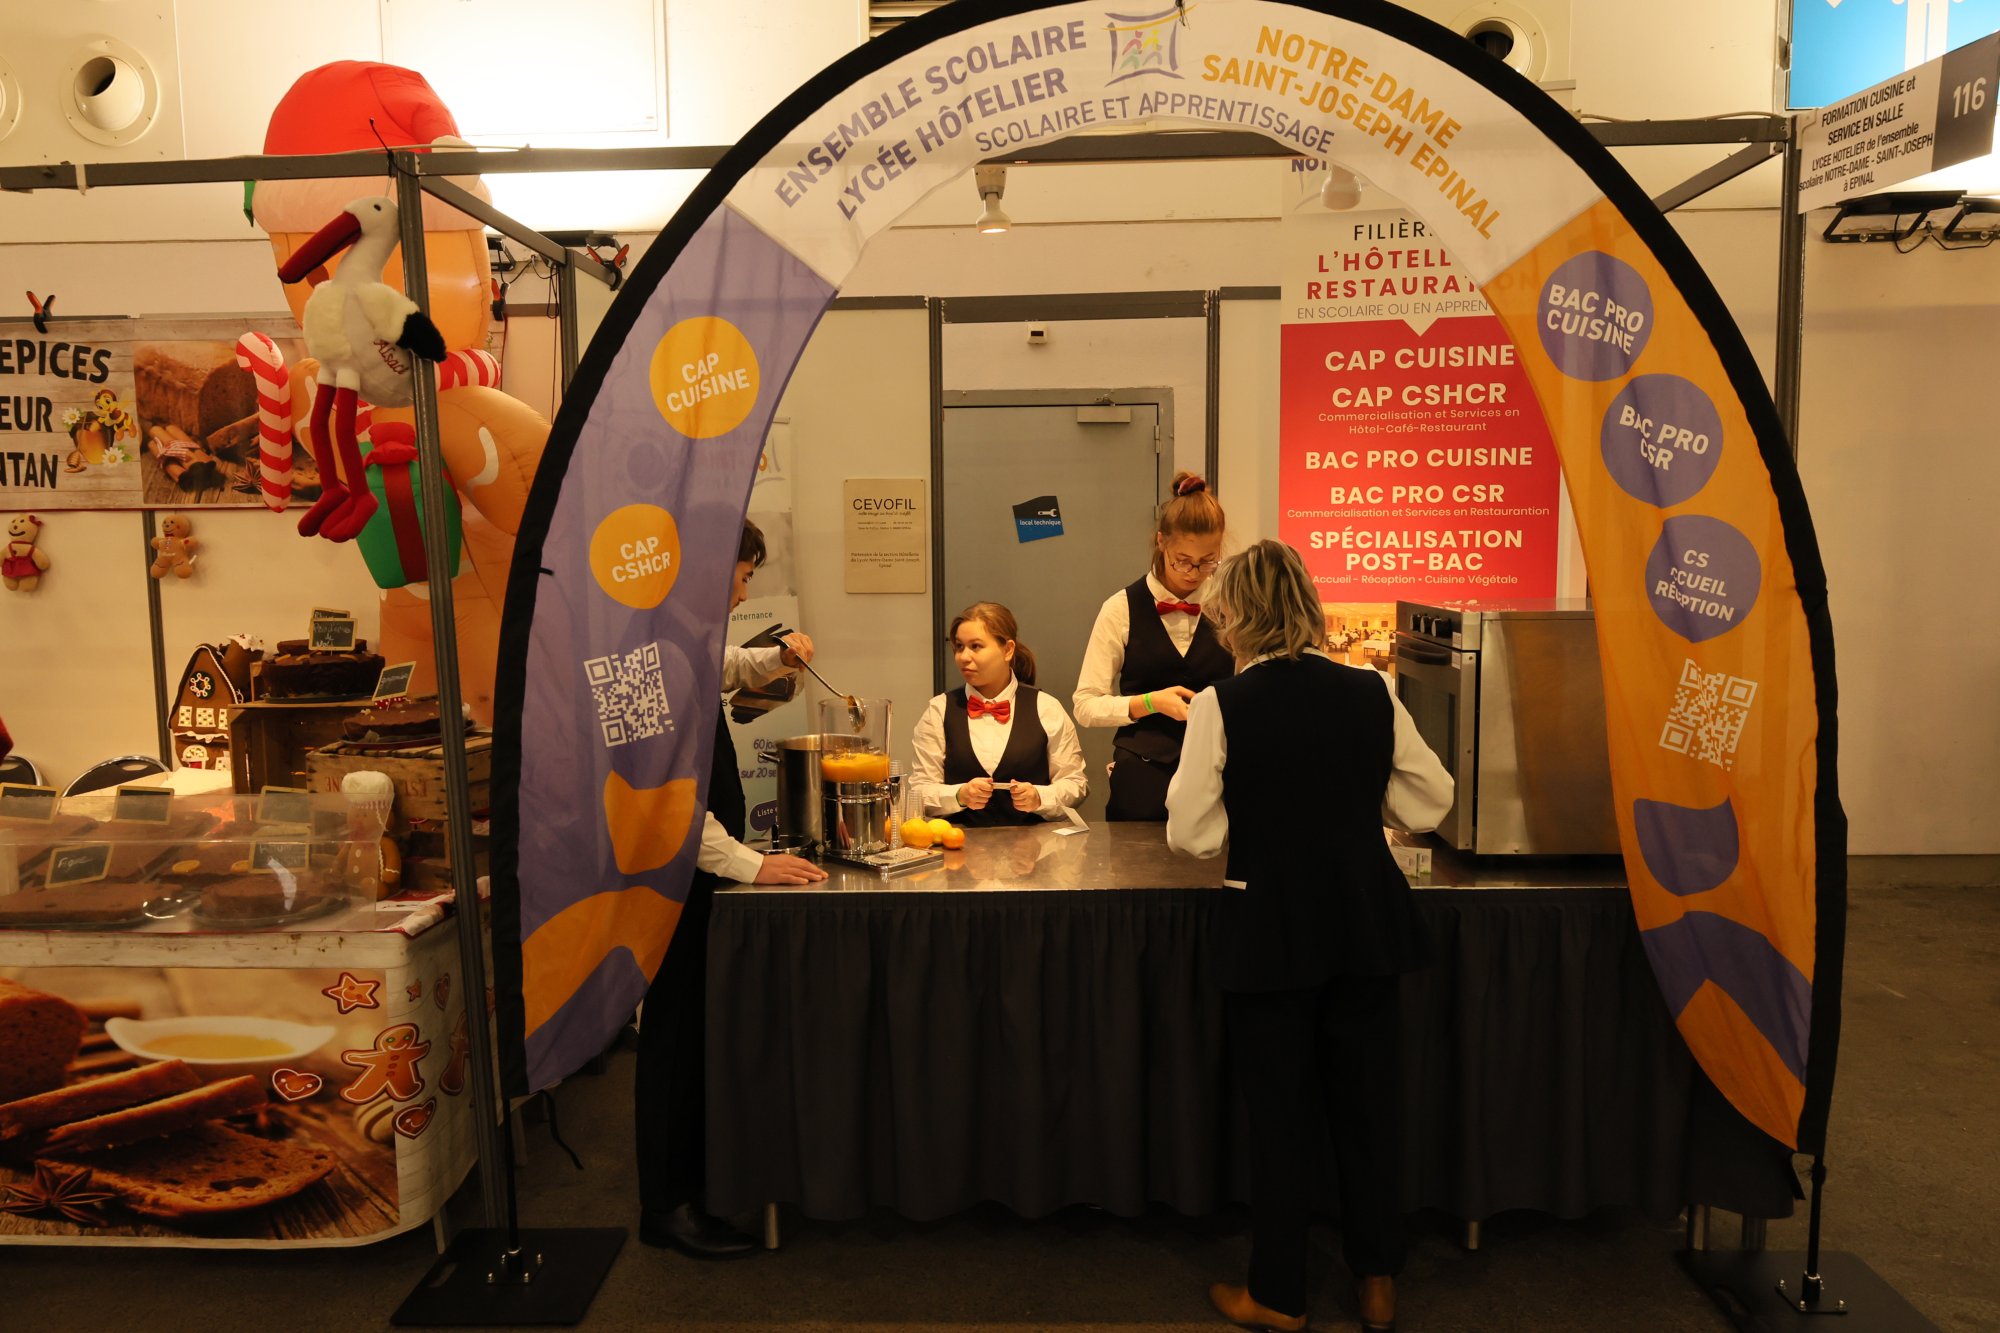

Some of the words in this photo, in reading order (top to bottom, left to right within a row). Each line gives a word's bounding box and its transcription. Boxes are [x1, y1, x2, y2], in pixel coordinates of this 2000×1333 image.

[1255, 25, 1462, 149] NOTRE-DAME
[1953, 77, 1986, 119] 116
[774, 77, 922, 207] ENSEMBLE
[925, 20, 1087, 95] SCOLAIRE
[1821, 95, 1868, 127] FORMATION
[1870, 79, 1905, 107] CUISINE
[1906, 76, 1916, 92] et
[975, 101, 1096, 152] SCOLAIRE
[1102, 96, 1130, 120] ET
[1139, 91, 1335, 153] APPRENTISSAGE
[1827, 120, 1862, 146] SERVICE
[1862, 116, 1874, 133] EN
[1875, 103, 1904, 127] SALLE
[837, 140, 917, 221] LYCÉE
[915, 67, 1068, 153] HÔTELIER
[1202, 54, 1413, 156] SAINT-JOSEPH
[1410, 143, 1500, 240] EPINAL
[1812, 153, 1832, 171] LYCEE
[1833, 141, 1865, 162] HOTELIER
[1866, 138, 1875, 151] de
[1877, 122, 1919, 147] l'ensemble
[1291, 159, 1327, 172] NO
[1799, 174, 1823, 192] scolaire
[1824, 155, 1870, 182] NOTRE-DAME
[1876, 132, 1934, 165] SAINT-JOSEPH
[1843, 180, 1848, 192] à
[1849, 171, 1875, 189] EPINAL
[1354, 218, 1433, 241] FILIÈR
[1318, 246, 1452, 273] L'HÔTELL
[1297, 307, 1314, 320] EN
[1318, 304, 1384, 318] SCOLAIRE
[1388, 303, 1410, 315] OU
[1413, 302, 1431, 314] EN
[1435, 299, 1488, 313] APPREN
[1548, 284, 1599, 313] BAC
[1604, 298, 1644, 333] PRO
[1547, 309, 1635, 355] CUISINE
[0, 339, 112, 384] EPICES
[682, 352, 719, 384] CAP
[1324, 349, 1386, 372] CAP
[1394, 344, 1515, 369] CUISINE
[666, 368, 750, 412] CUISINE
[1332, 386, 1393, 408] CAP
[1401, 382, 1507, 406] CSHCR
[1318, 410, 1431, 422] Commercialisation
[1435, 410, 1447, 419] et
[1450, 408, 1501, 418] Services
[1505, 409, 1520, 417] en
[1349, 422, 1487, 435] Hôtel-Café-Restaurant
[1619, 405, 1653, 438] BAC
[1657, 424, 1709, 454] PRO
[1305, 451, 1359, 469] BAC
[1366, 450, 1419, 468] PRO
[1426, 447, 1534, 467] CUISINE
[1640, 438, 1674, 471] CSR
[853, 498, 916, 510] CEVOFIL
[1330, 486, 1384, 505] BAC
[1392, 485, 1444, 504] PRO
[1452, 484, 1505, 503] CSR
[1034, 519, 1061, 527] technique
[1287, 508, 1389, 519] Commercialisation
[1391, 508, 1403, 517] et
[1405, 507, 1451, 517] Services
[1453, 508, 1468, 516] en
[1470, 506, 1550, 517] Restaurantion
[620, 536, 659, 560] CAP
[1309, 525, 1523, 549] SPÉCIALISATION
[612, 551, 671, 583] CSHCR
[1346, 552, 1484, 571] POST-BAC
[1683, 549, 1710, 568] CS
[1312, 574, 1351, 584] Accueil
[1361, 574, 1416, 586] Réception
[1424, 575, 1465, 584] Cuisine
[1468, 574, 1518, 586] Végétale
[731, 611, 773, 621] alternance
[753, 739, 765, 750] 60
[741, 769, 755, 778] sur
[756, 767, 768, 778] 20
[757, 808, 774, 817] Liste
